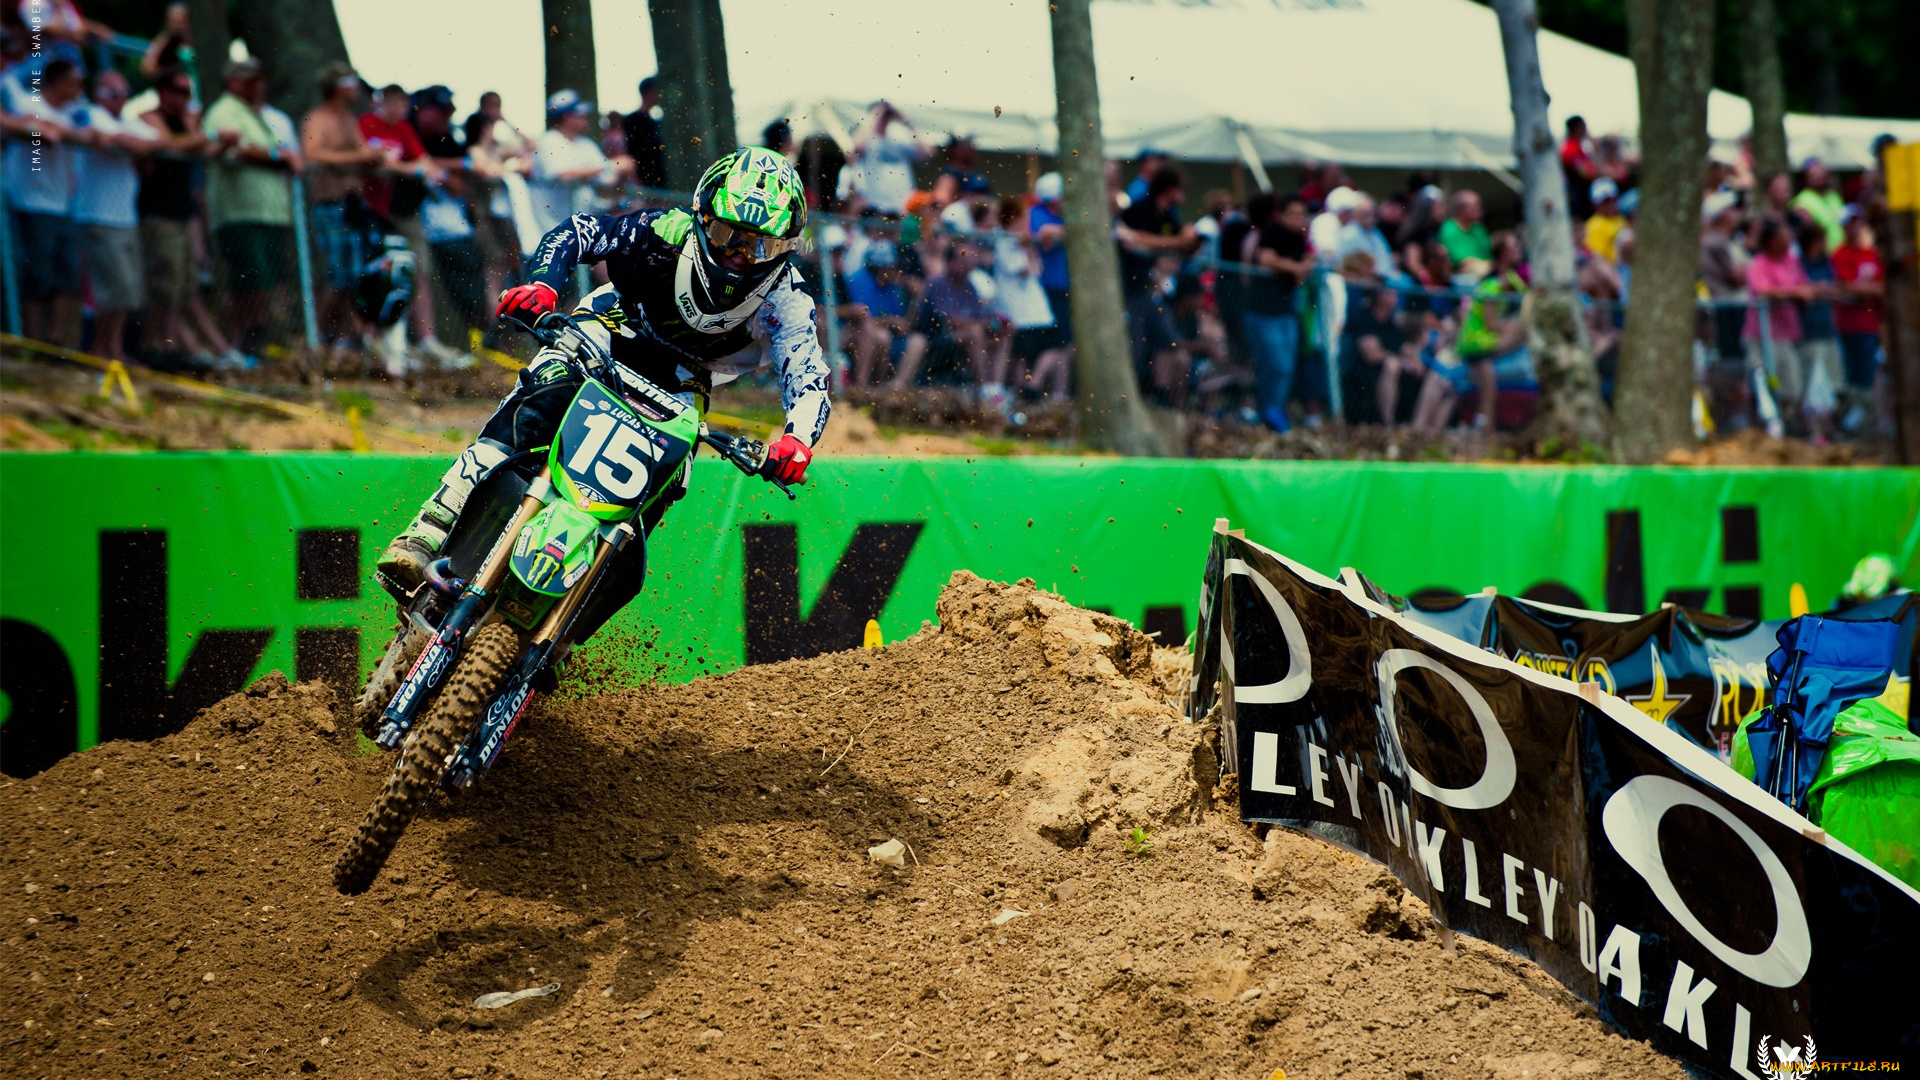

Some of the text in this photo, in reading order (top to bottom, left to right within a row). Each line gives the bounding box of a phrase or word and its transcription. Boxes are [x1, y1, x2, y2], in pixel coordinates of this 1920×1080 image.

[540, 229, 573, 267] MONSTER
[678, 291, 697, 319] VANS
[610, 407, 641, 429] LUCAS
[567, 412, 665, 500] 15
[478, 682, 530, 764] DUNLOP
[1578, 900, 1806, 1080] OAKL
